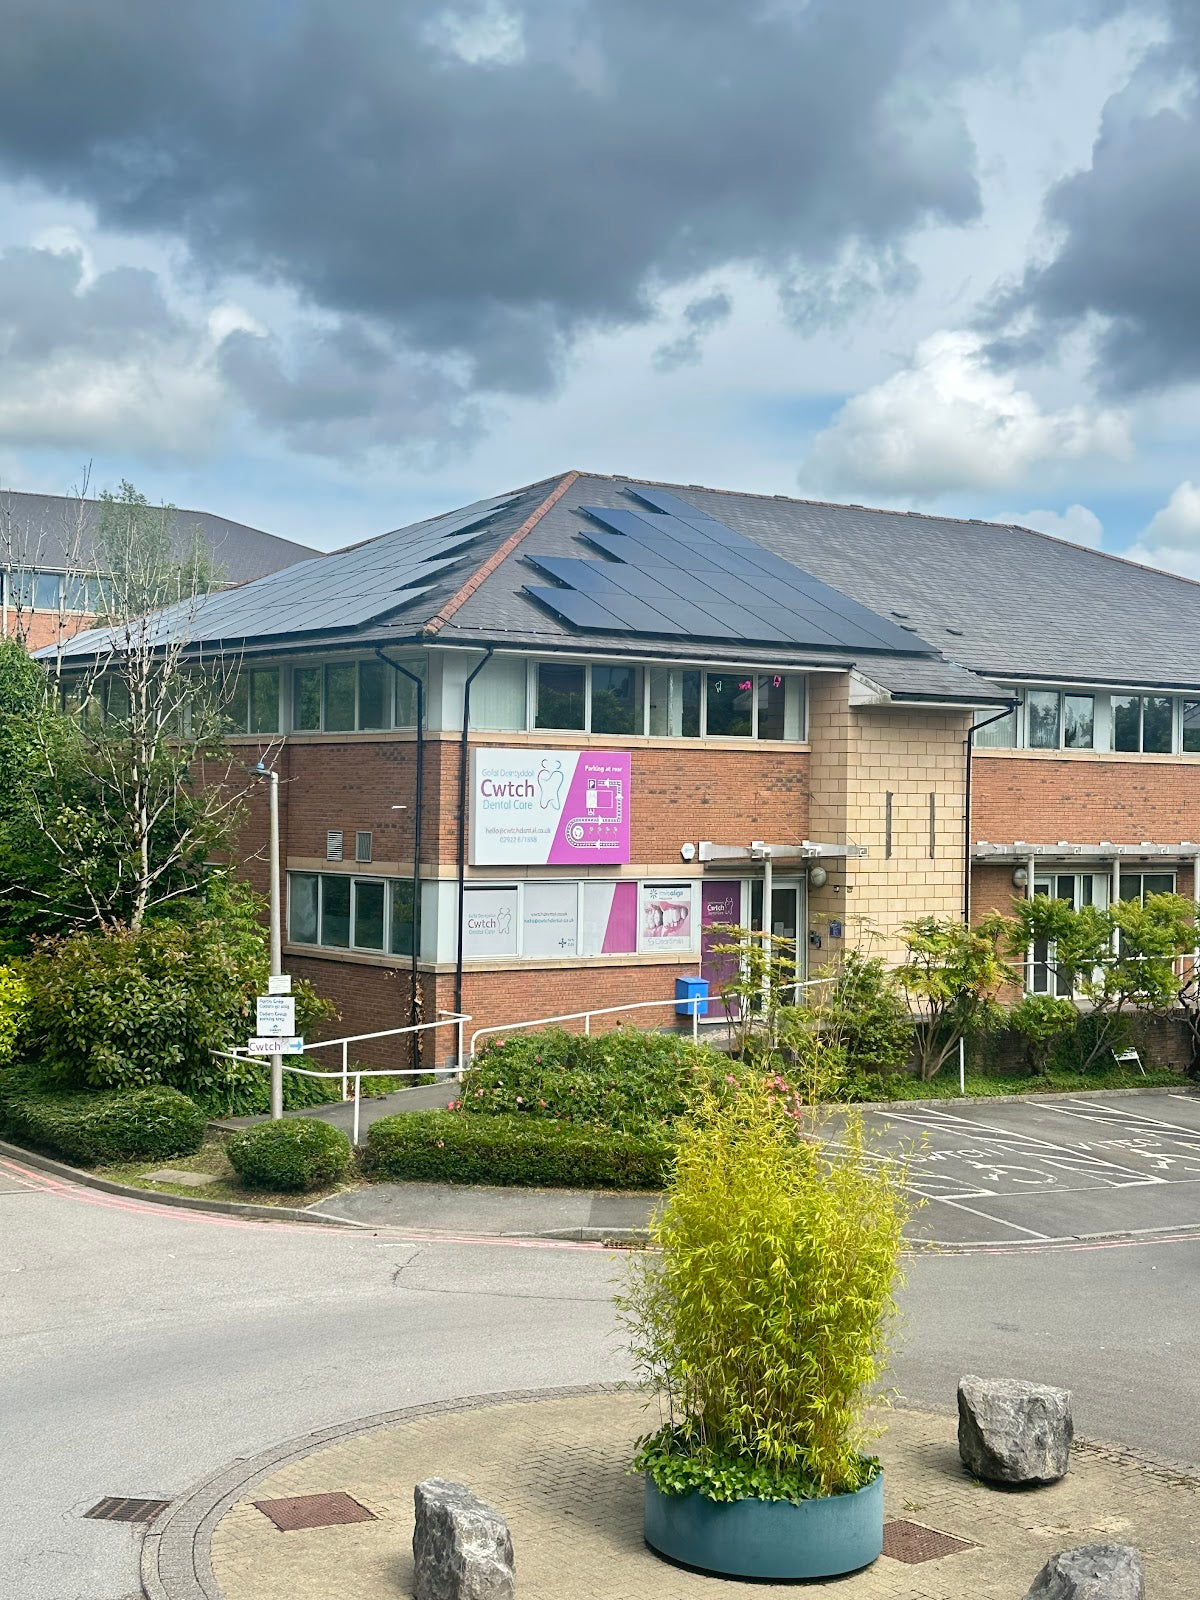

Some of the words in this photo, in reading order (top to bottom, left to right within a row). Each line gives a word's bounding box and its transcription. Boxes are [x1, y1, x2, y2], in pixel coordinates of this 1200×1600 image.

[482, 769, 499, 777] Gofal
[584, 765, 605, 773] Parking
[480, 779, 535, 797] Cwtch
[483, 800, 512, 810] Dental
[513, 800, 533, 810] Care
[707, 904, 725, 912] Cwtch
[467, 918, 497, 929] Cwtch
[249, 1042, 281, 1051] Cwtch
[1066, 1139, 1162, 1150] VITEC
